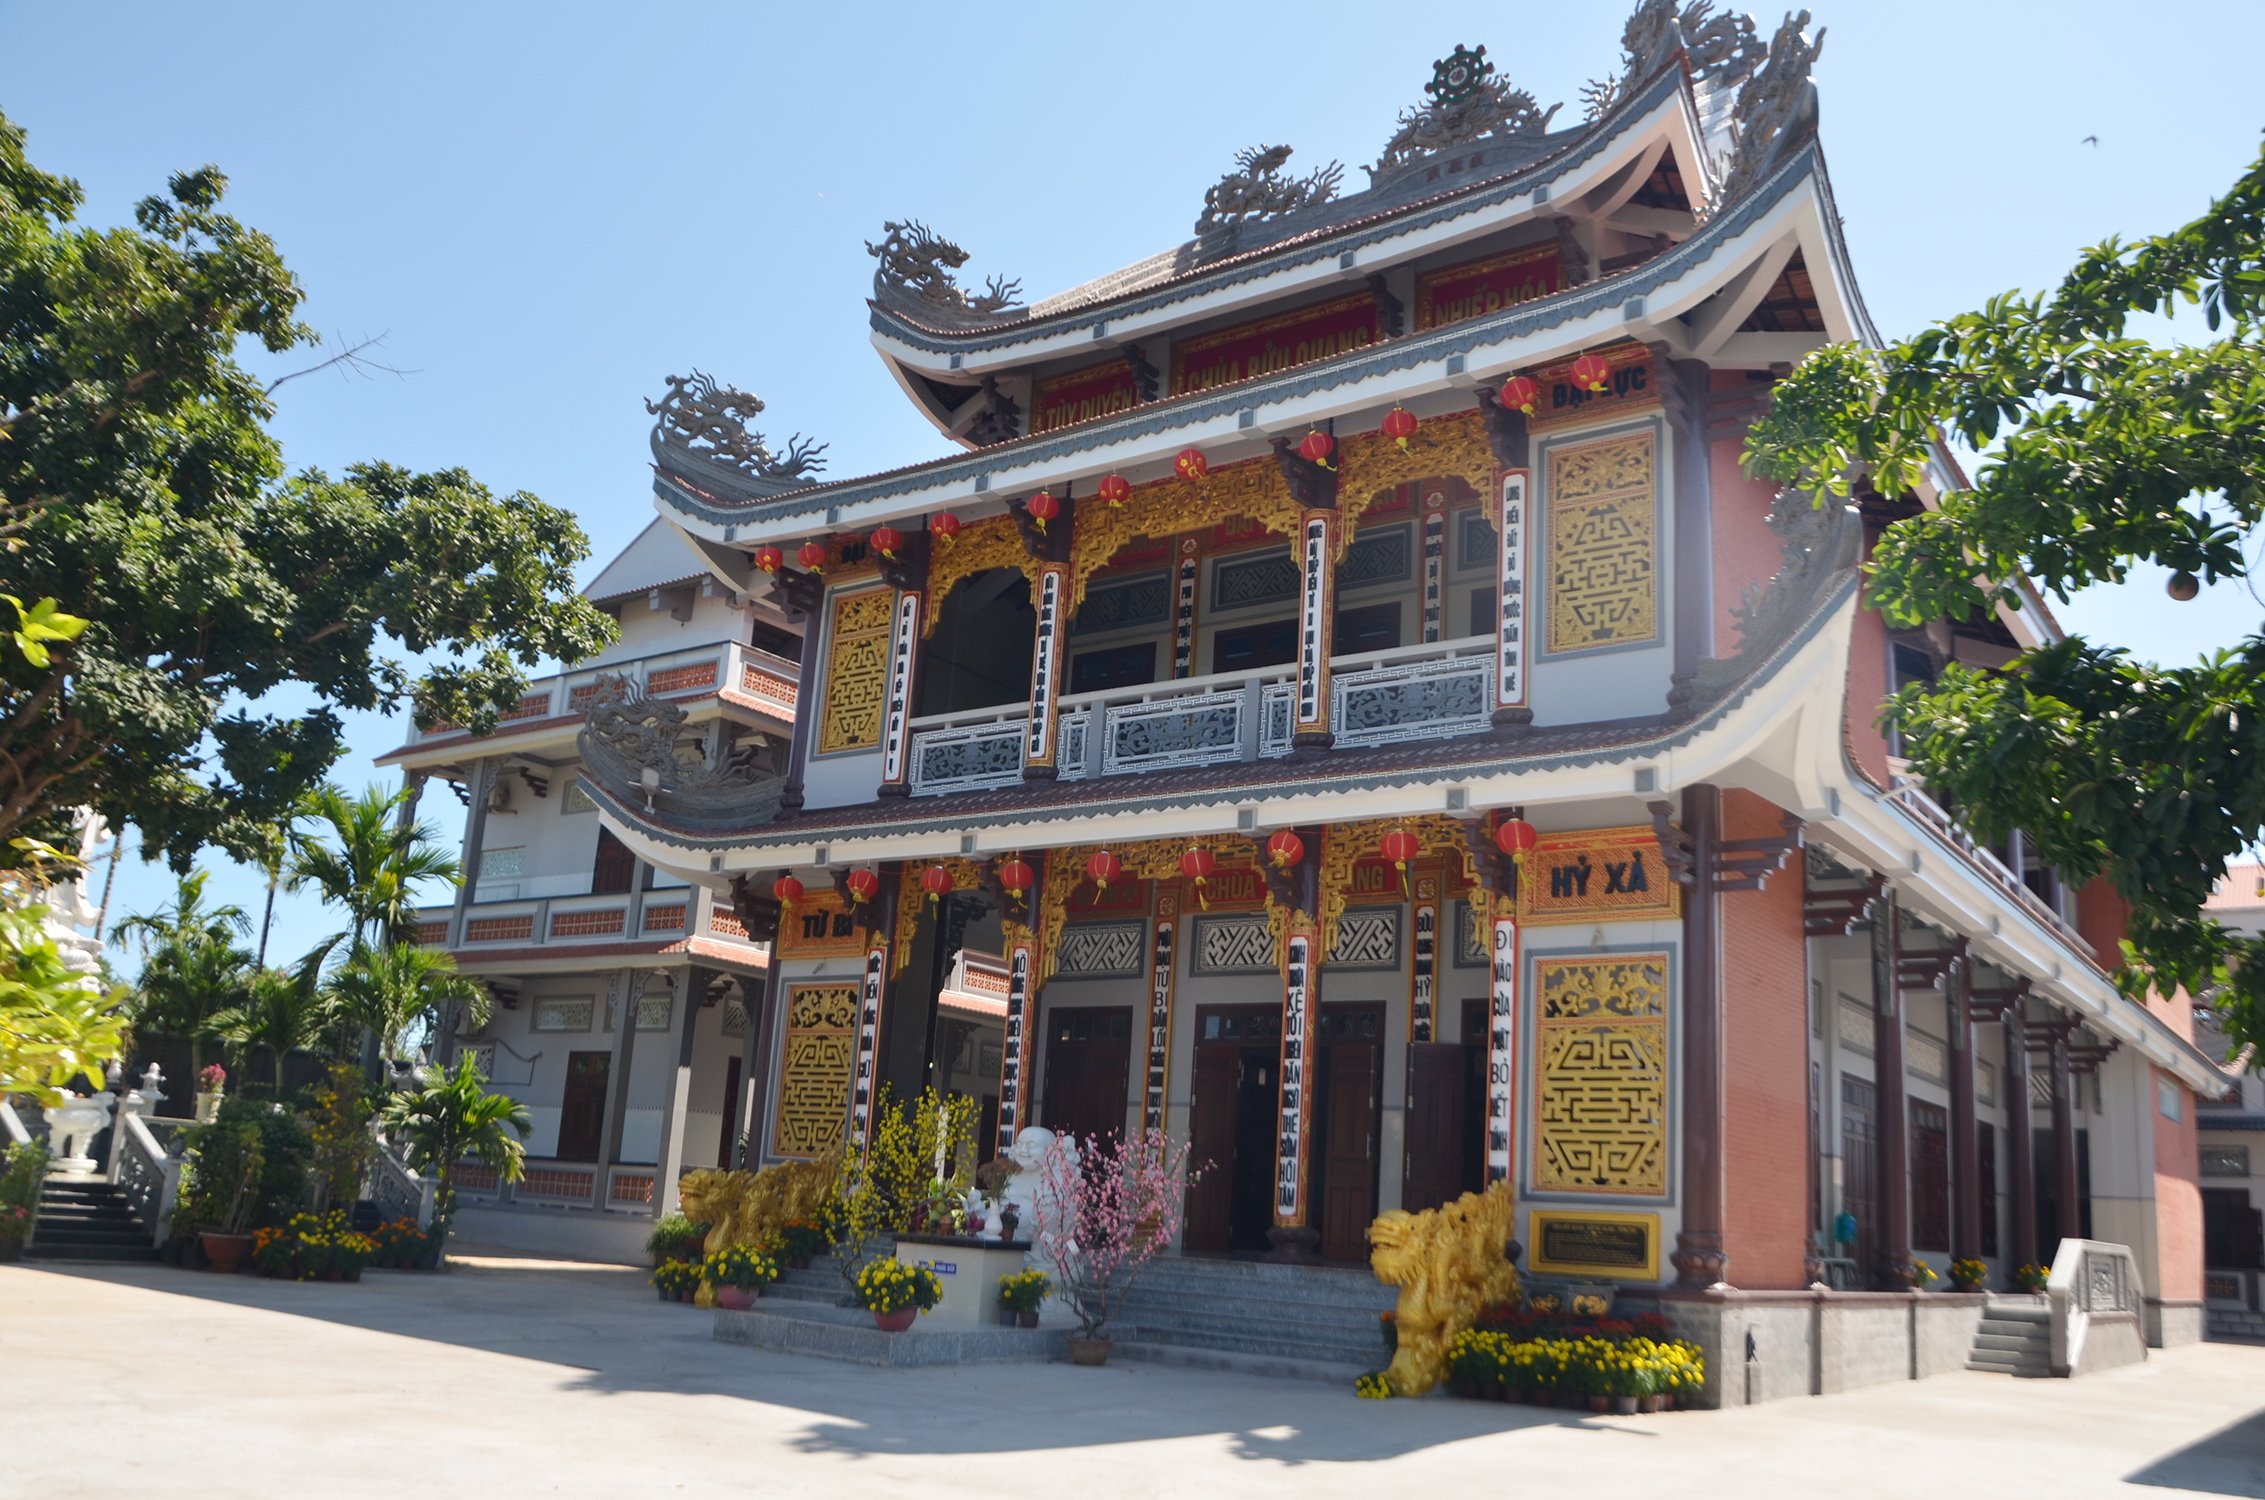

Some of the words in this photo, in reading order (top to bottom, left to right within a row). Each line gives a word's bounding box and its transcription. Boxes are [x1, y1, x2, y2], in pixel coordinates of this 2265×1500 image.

[1188, 356, 1241, 392] CHÙA
[1206, 868, 1258, 900] CHÙA
[1551, 855, 1592, 897] HỶ
[1604, 850, 1648, 894] XẢ
[802, 908, 829, 939] TỪ
[1495, 929, 1513, 950] ĐI
[1494, 958, 1512, 982] VÀO
[1154, 991, 1168, 1007] BI
[1491, 1057, 1509, 1084] BỎ
